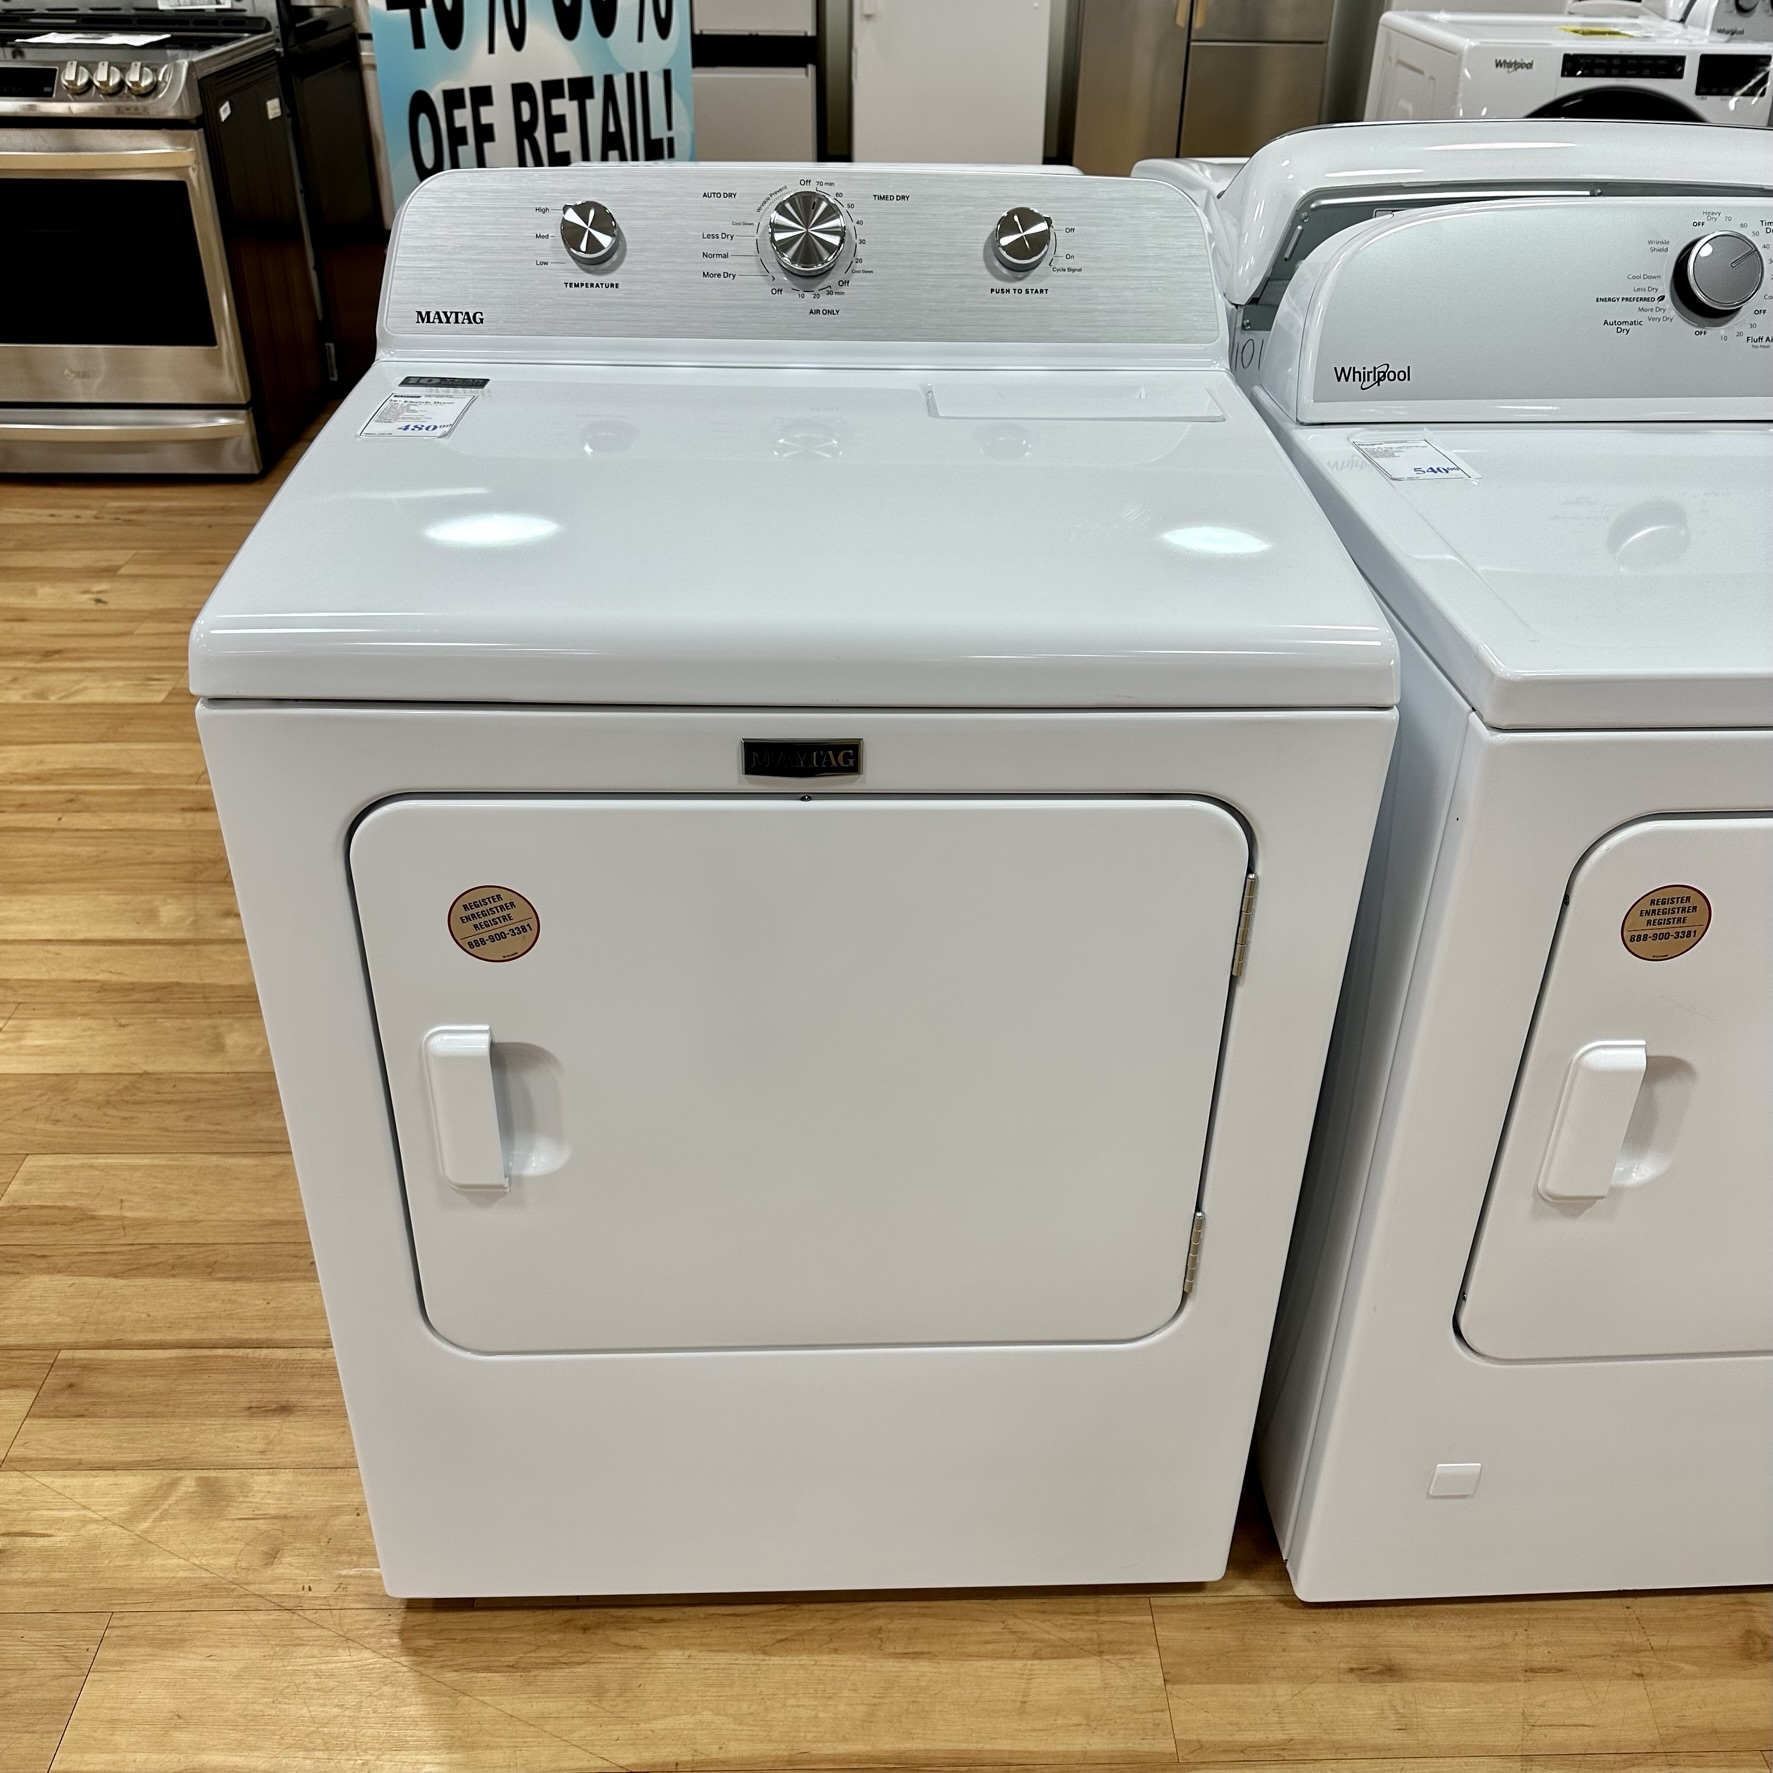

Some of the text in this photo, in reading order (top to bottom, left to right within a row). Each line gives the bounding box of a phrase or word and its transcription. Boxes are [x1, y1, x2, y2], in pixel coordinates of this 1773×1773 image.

[1494, 58, 1534, 73] Whirlpool
[408, 68, 676, 183] OFF RETAIL!
[799, 178, 811, 186] Off
[702, 191, 737, 199] AUTO DRY
[872, 194, 910, 202] TIMED DRY
[535, 206, 550, 214] High
[535, 232, 550, 240] Med
[702, 232, 735, 241] Less Dry
[702, 251, 729, 260] Normal
[535, 259, 549, 267] Low
[702, 271, 737, 281] More Dry
[563, 281, 620, 290] TEMPERATURE
[837, 279, 850, 287] Off
[770, 287, 783, 295] Off
[808, 308, 840, 316] AIR ONLY
[1655, 306, 1667, 314] Dry
[415, 310, 485, 325] MAYTAG
[1602, 319, 1644, 327] Automatic
[1615, 326, 1631, 336] Dry
[1746, 335, 1764, 343] Fluff
[1333, 363, 1411, 391] Whirlpool
[462, 893, 504, 912] REGISTER
[1650, 896, 1691, 906] REGISTER
[459, 900, 517, 924] ENREGISTRER
[1639, 905, 1697, 917] ENREGISTRER
[472, 912, 514, 932] REGISTRE
[1646, 916, 1687, 926] REGISTRE
[466, 922, 533, 950] 888-900-3381
[1629, 930, 1697, 942] 888-900-3381
